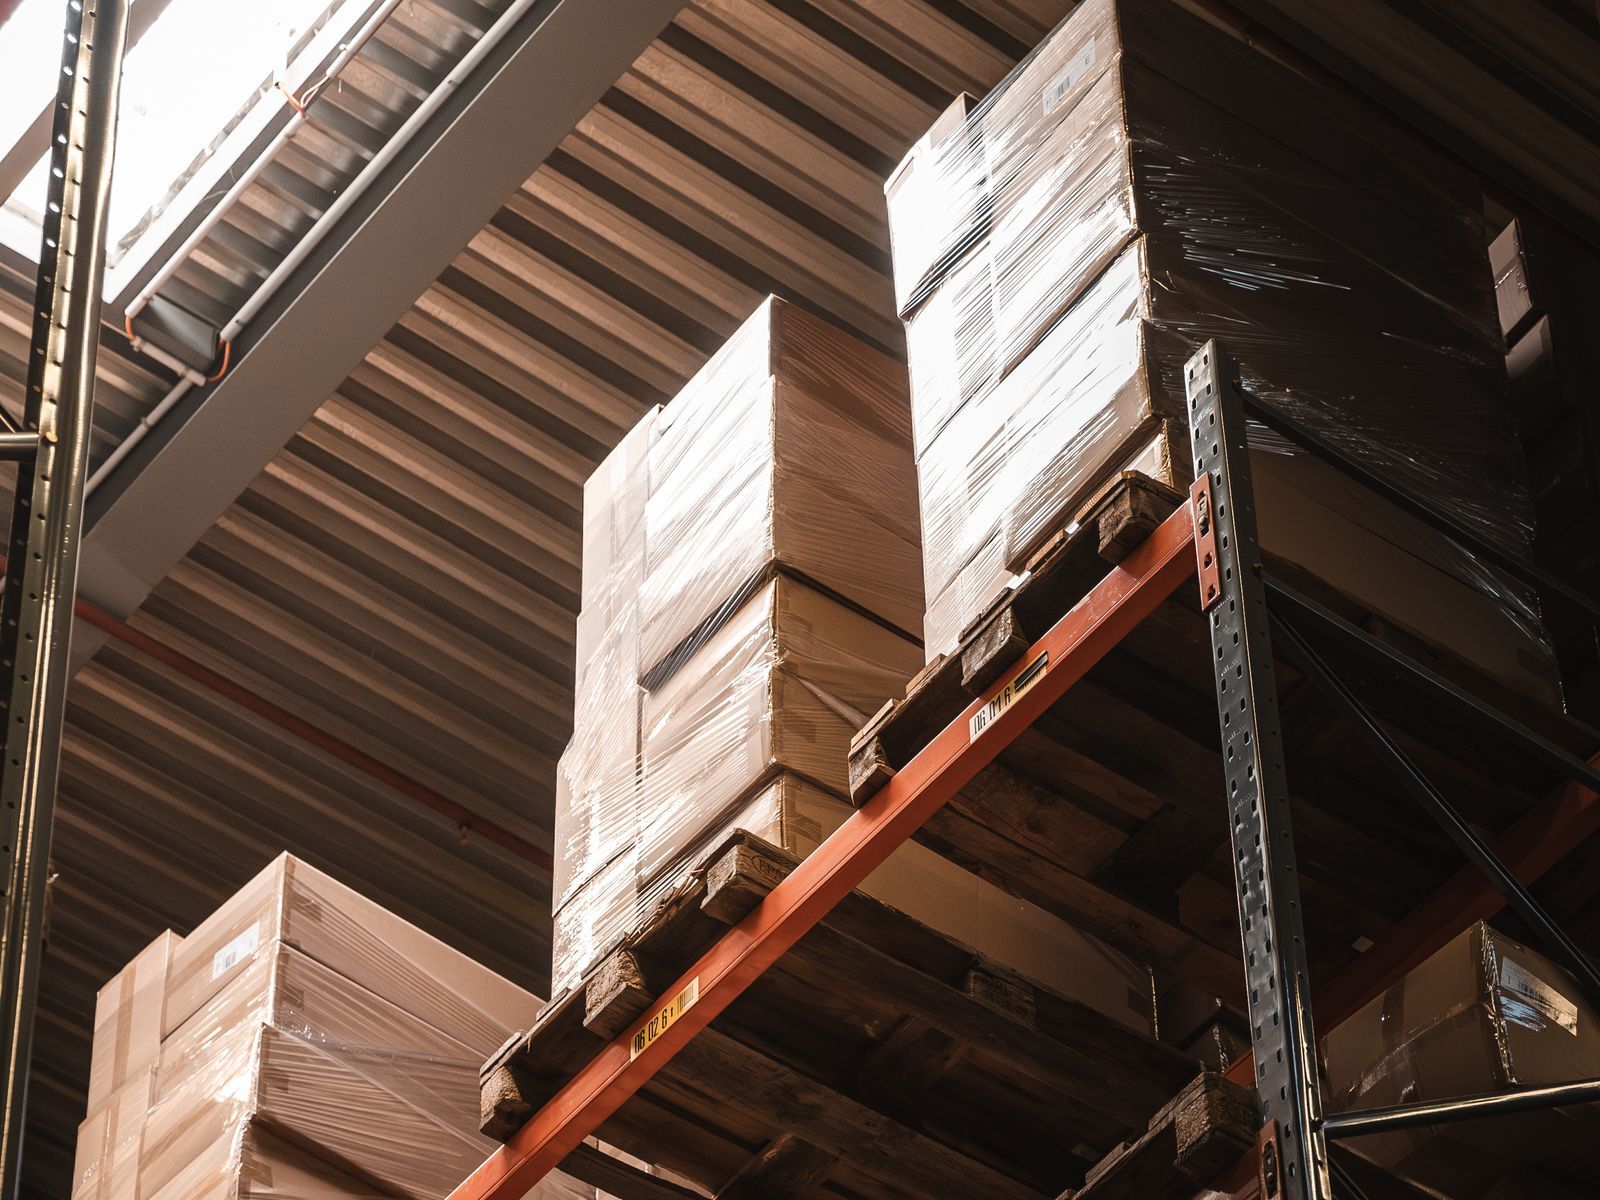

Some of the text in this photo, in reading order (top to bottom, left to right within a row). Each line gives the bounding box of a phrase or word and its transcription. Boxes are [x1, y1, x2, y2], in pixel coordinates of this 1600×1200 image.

[634, 1008, 668, 1055] 06 02 6
